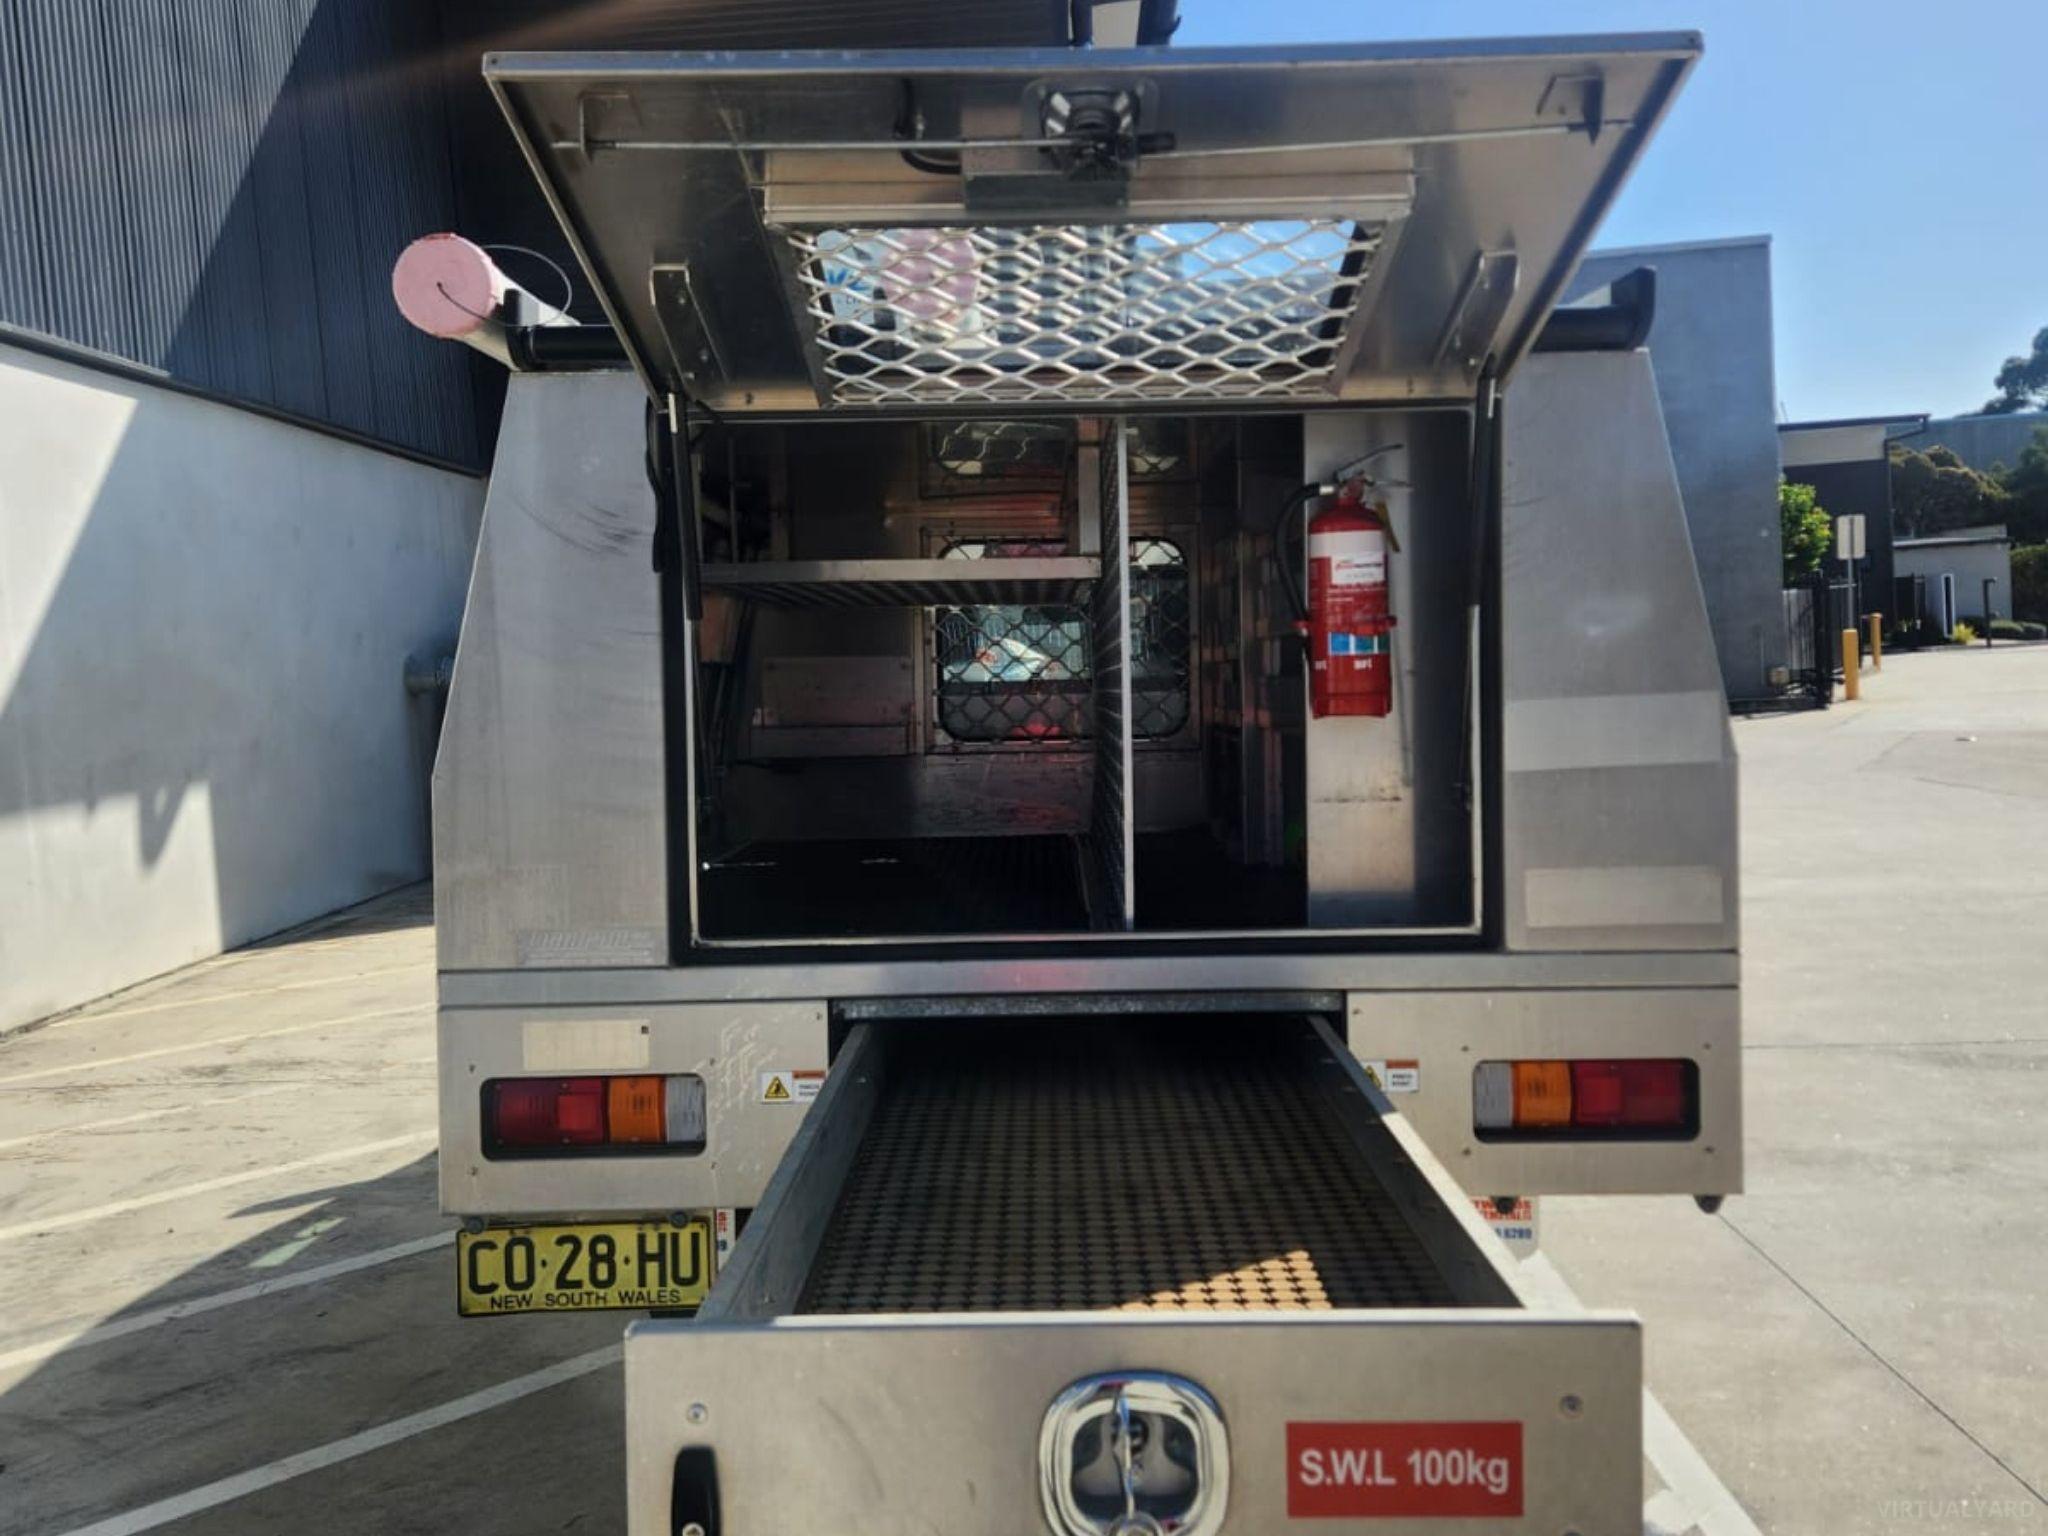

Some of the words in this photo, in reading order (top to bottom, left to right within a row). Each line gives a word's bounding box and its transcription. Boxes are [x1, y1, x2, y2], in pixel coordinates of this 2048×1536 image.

[489, 1295, 533, 1311] NEW
[545, 1292, 609, 1307] SOUTH
[617, 1289, 683, 1304] WALES
[1300, 1449, 1396, 1486] S.W.L
[1406, 1449, 1509, 1495] 100kg
